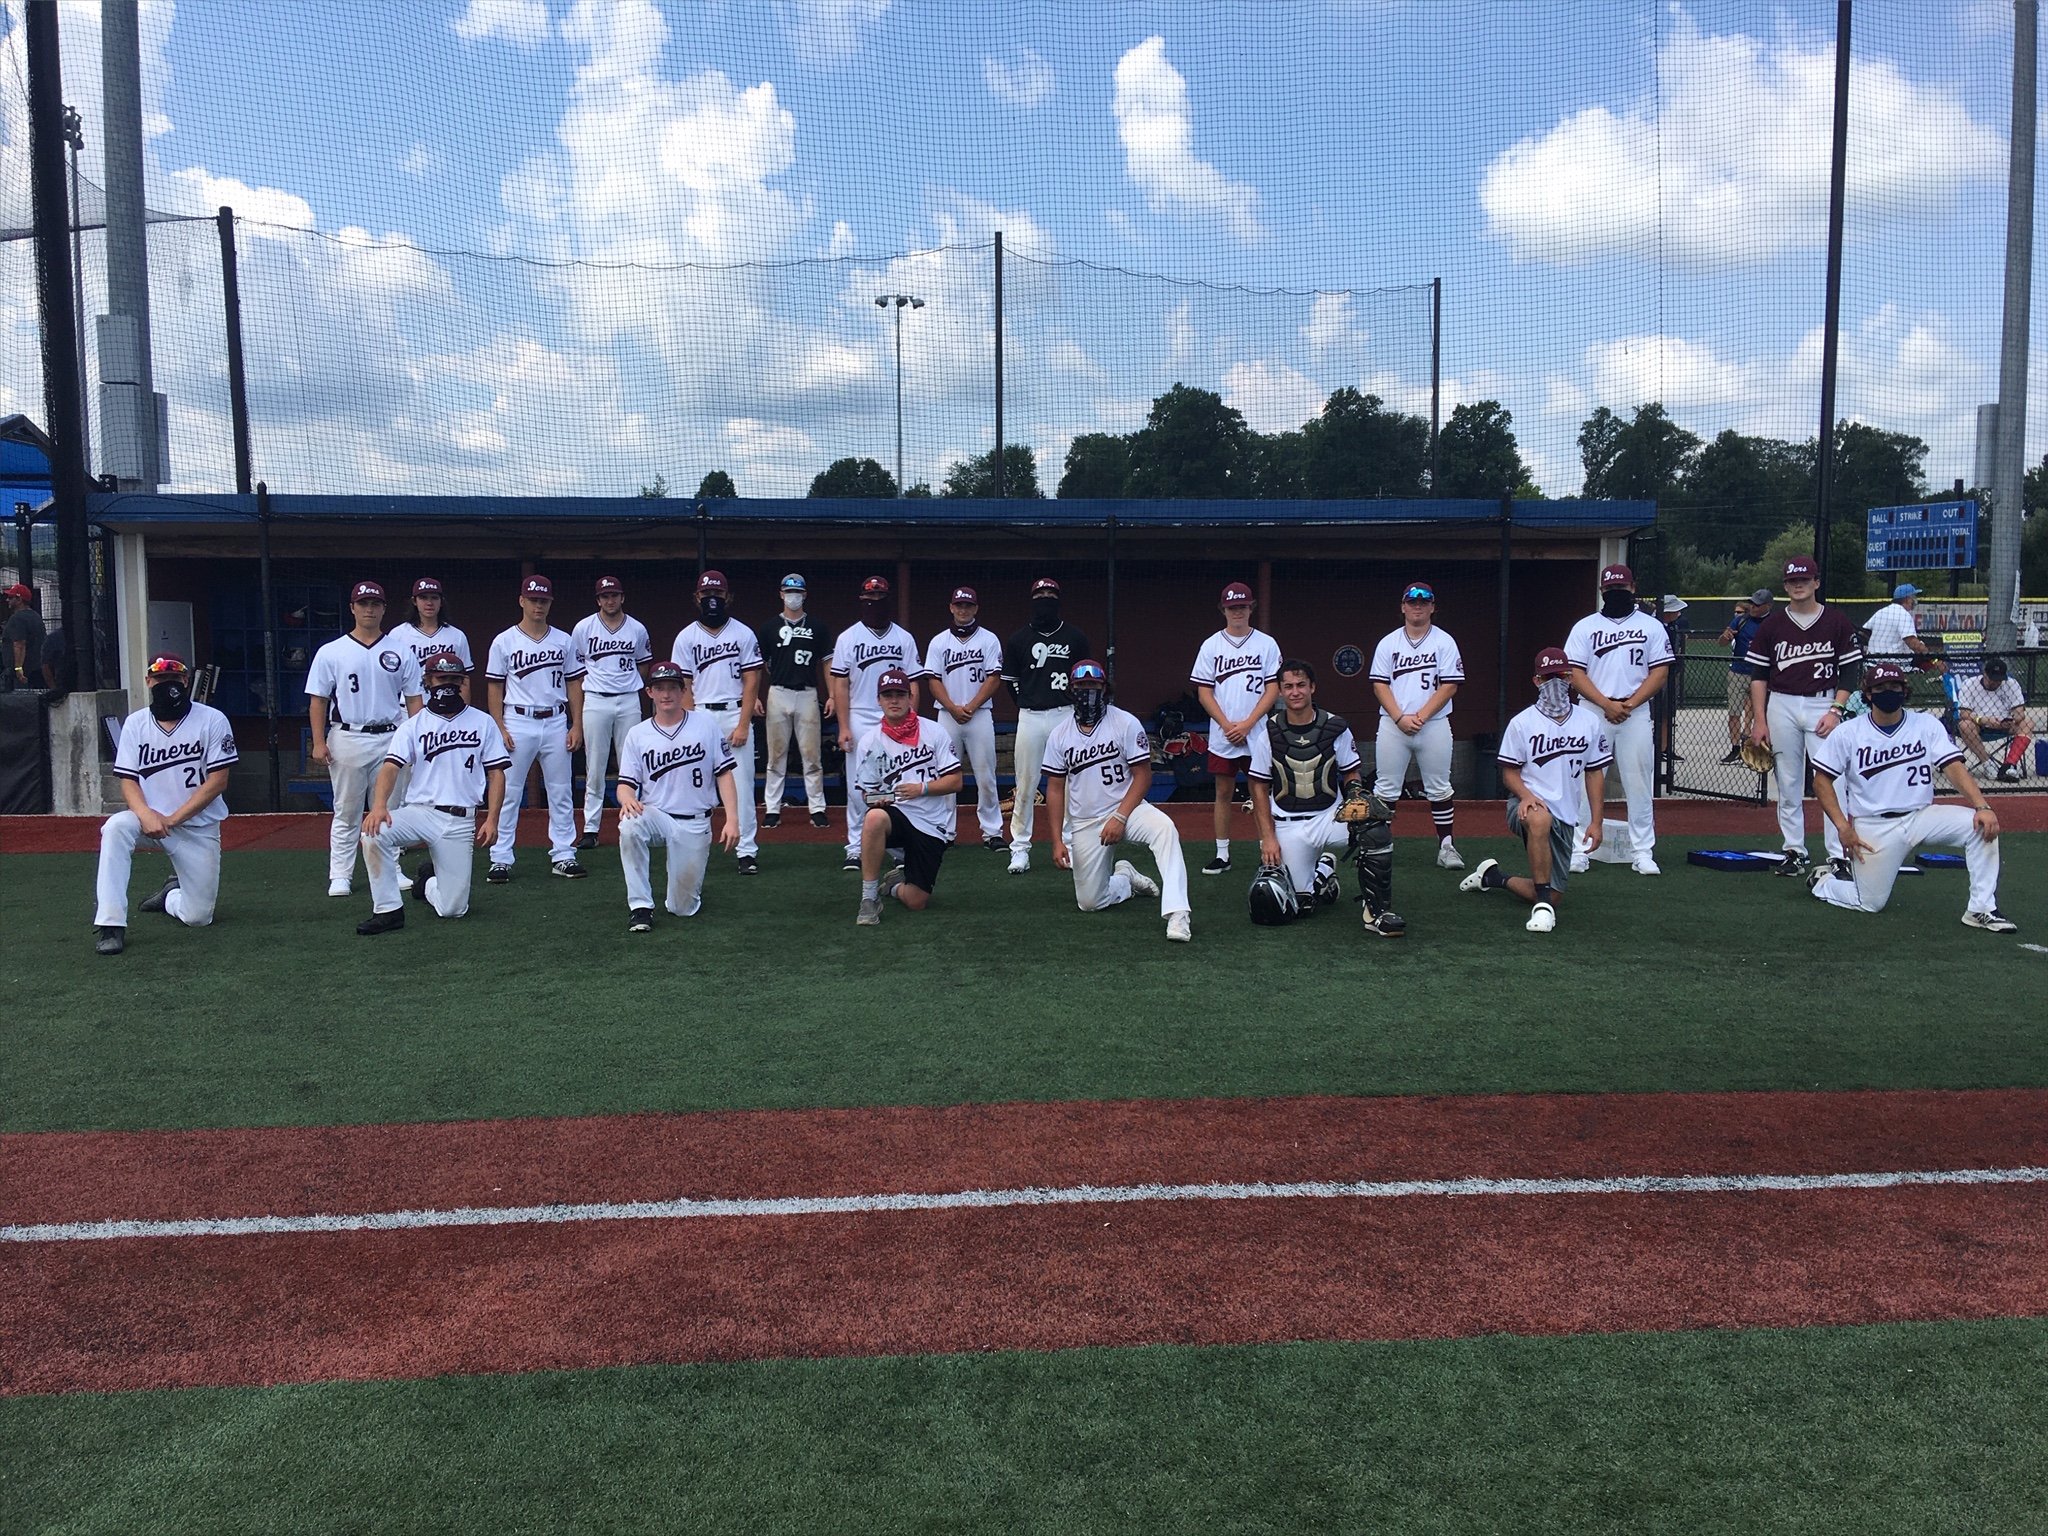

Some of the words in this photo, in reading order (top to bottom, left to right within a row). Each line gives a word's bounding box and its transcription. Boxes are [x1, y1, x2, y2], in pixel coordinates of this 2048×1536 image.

[1872, 514, 1888, 524] BALL
[1900, 511, 1922, 522] STRIKE
[1943, 508, 1958, 518] OUT
[1952, 528, 1970, 536] TOTAL
[1868, 542, 1887, 552] GUEST
[1786, 563, 1808, 574] 9ers
[1868, 557, 1885, 567] HOME
[358, 585, 380, 595] 9ers
[589, 637, 635, 654] Niners
[777, 625, 813, 647] 9ers
[1591, 629, 1645, 649] Niners
[511, 650, 564, 669] Niners
[692, 641, 740, 665] Niners
[794, 650, 813, 665] 67
[854, 643, 902, 662] Niners
[943, 648, 984, 667] Niners
[1030, 642, 1070, 669] 9ers
[1629, 648, 1643, 665] 12
[1774, 640, 1834, 660] Niners
[1214, 654, 1262, 673] Niners
[1392, 652, 1437, 669] Niners
[729, 662, 741, 679] 13
[969, 667, 985, 683] 30
[1875, 668, 1898, 679] 9ers
[348, 673, 360, 693] 3
[881, 675, 902, 686] 9ers
[1051, 672, 1069, 691] 28
[1246, 674, 1263, 694] 22
[1421, 673, 1438, 690] 54
[419, 730, 481, 755] Niners
[1529, 733, 1588, 757] Niners
[139, 740, 203, 766] Niners
[642, 742, 704, 773] Niners
[876, 744, 934, 777] Niners
[1064, 740, 1119, 768] Niners
[1856, 740, 1926, 769] Niners
[464, 754, 475, 773] 4
[692, 768, 703, 788] 8
[916, 766, 937, 782] 75
[1101, 764, 1125, 786] 59
[1906, 765, 1932, 786] 29
